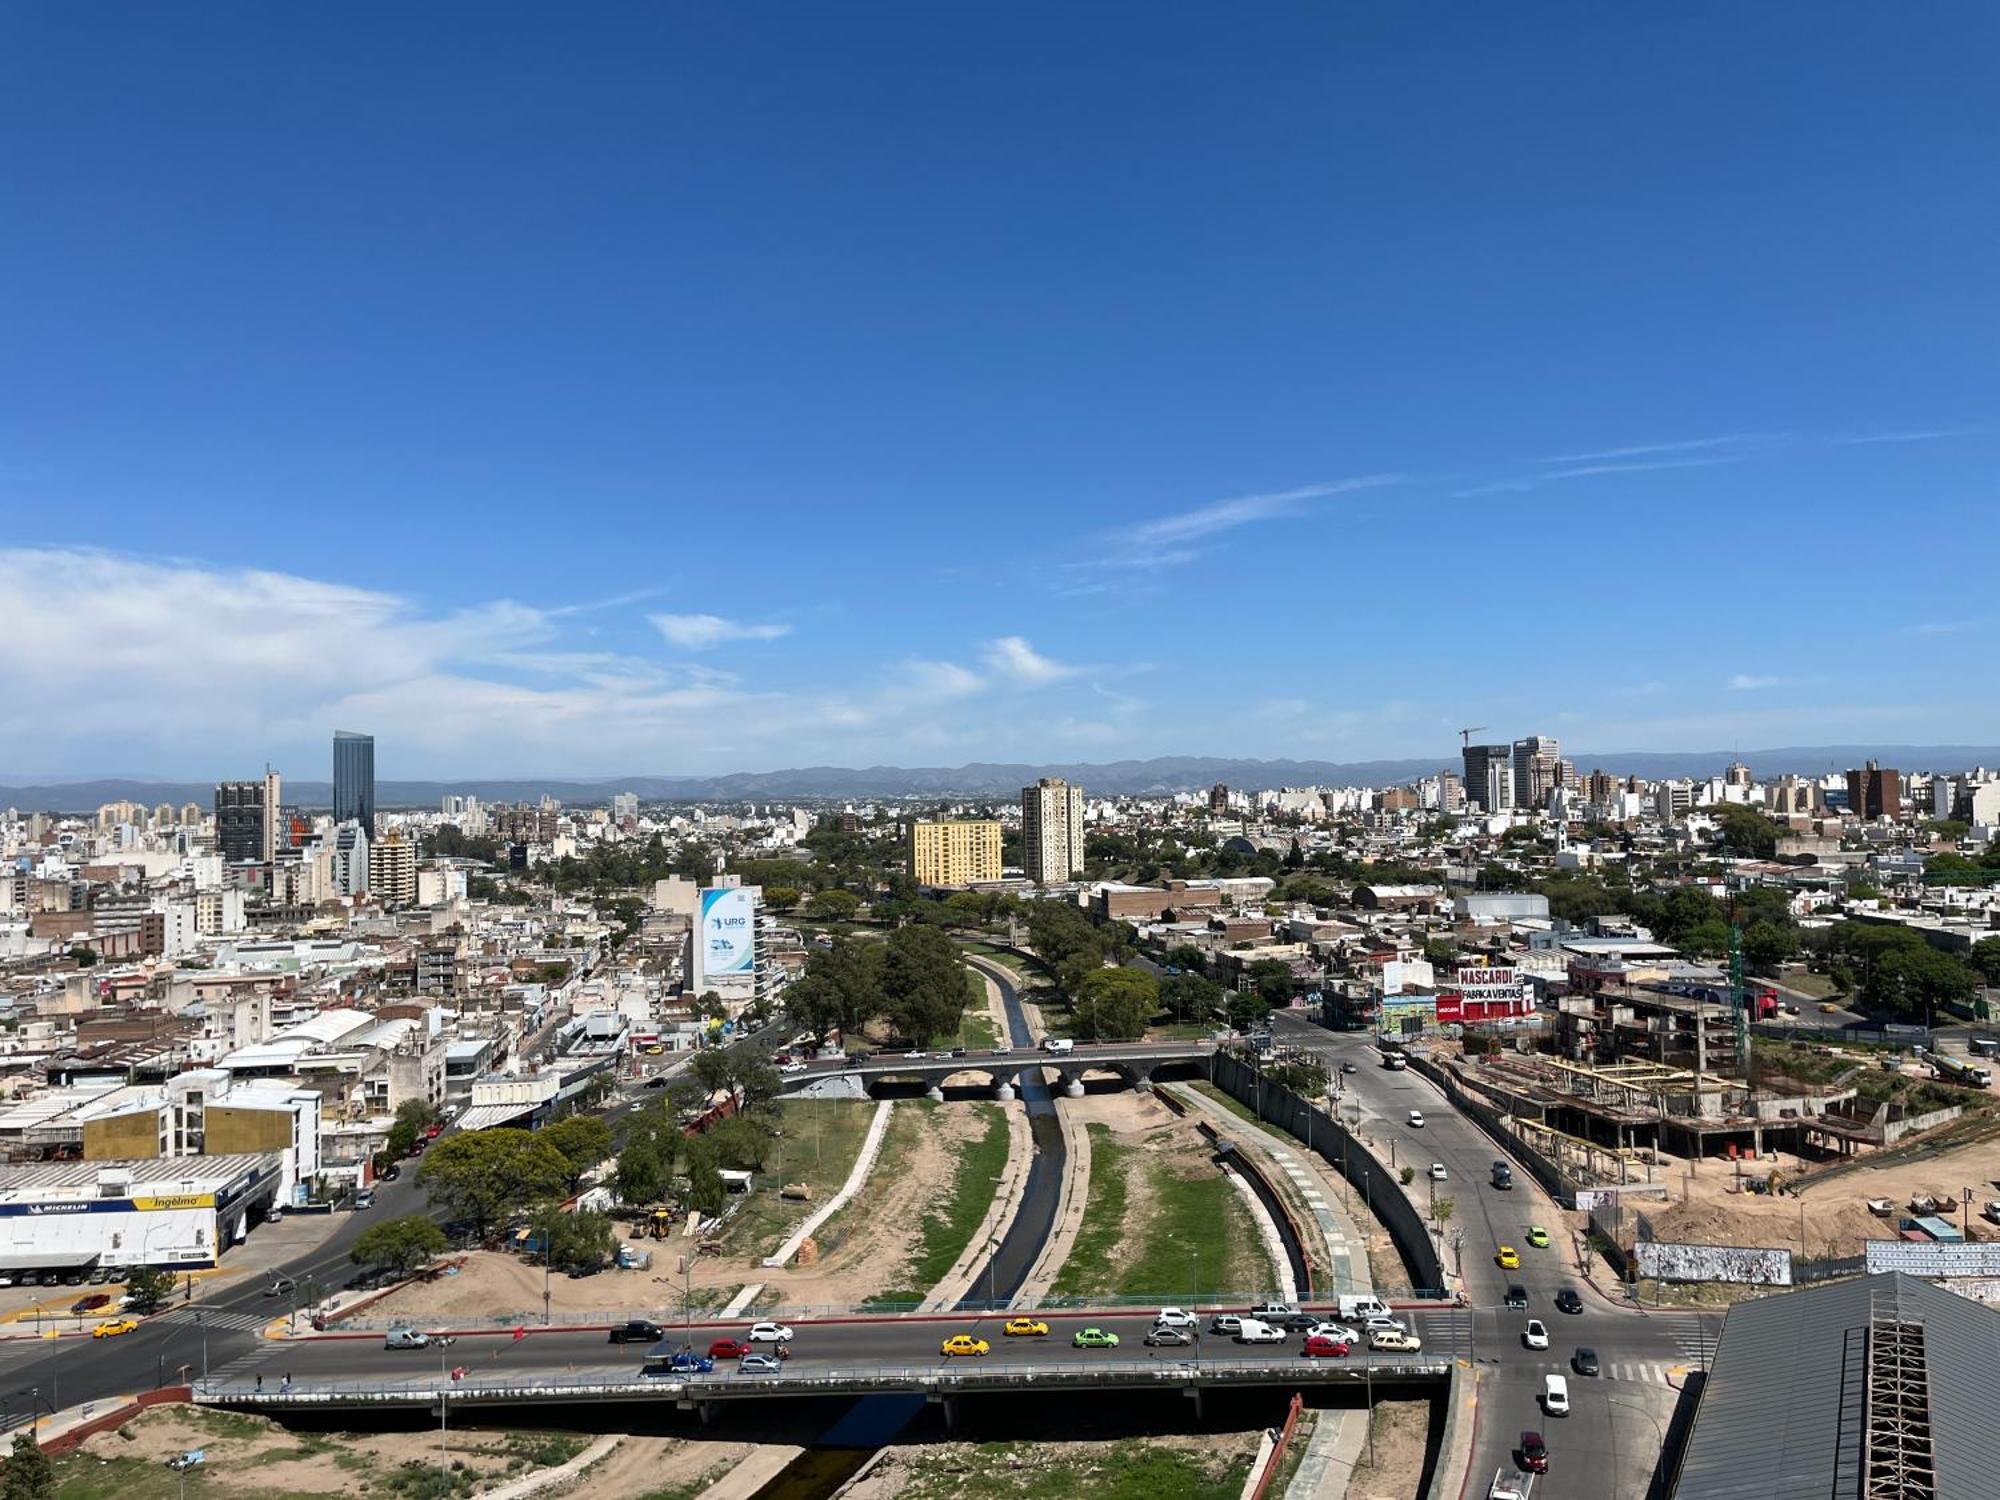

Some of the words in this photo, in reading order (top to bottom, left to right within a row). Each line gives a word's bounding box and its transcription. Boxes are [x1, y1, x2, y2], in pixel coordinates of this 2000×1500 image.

[724, 917, 746, 926] URG
[1461, 969, 1512, 984] MASCARDI
[1463, 988, 1492, 999] FABRICA
[1492, 987, 1522, 998] VENTAS
[43, 1203, 88, 1212] MICHELIN
[154, 1196, 197, 1208] Ingelmo
